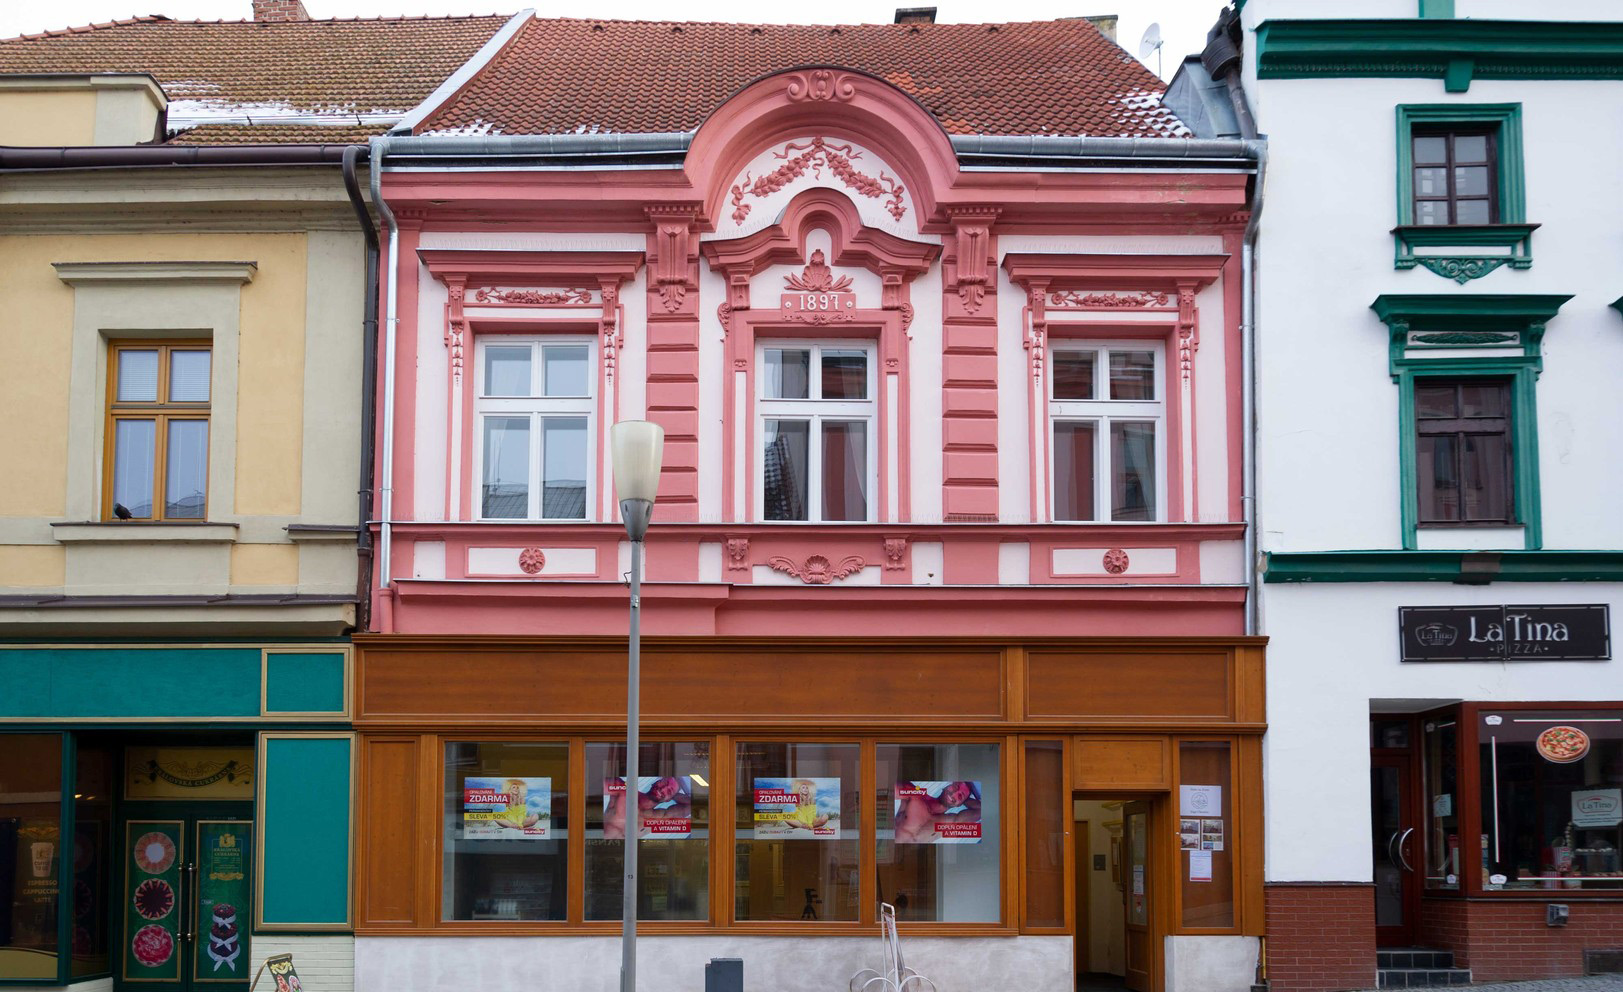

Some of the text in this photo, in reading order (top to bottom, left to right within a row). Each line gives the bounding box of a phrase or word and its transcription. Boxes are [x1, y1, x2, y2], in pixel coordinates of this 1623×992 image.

[799, 295, 839, 311] 1897
[1497, 644, 1543, 654] PIZZA
[900, 787, 927, 796] suncity
[469, 795, 508, 803] ZDARMA
[758, 795, 798, 803] ZDARMA
